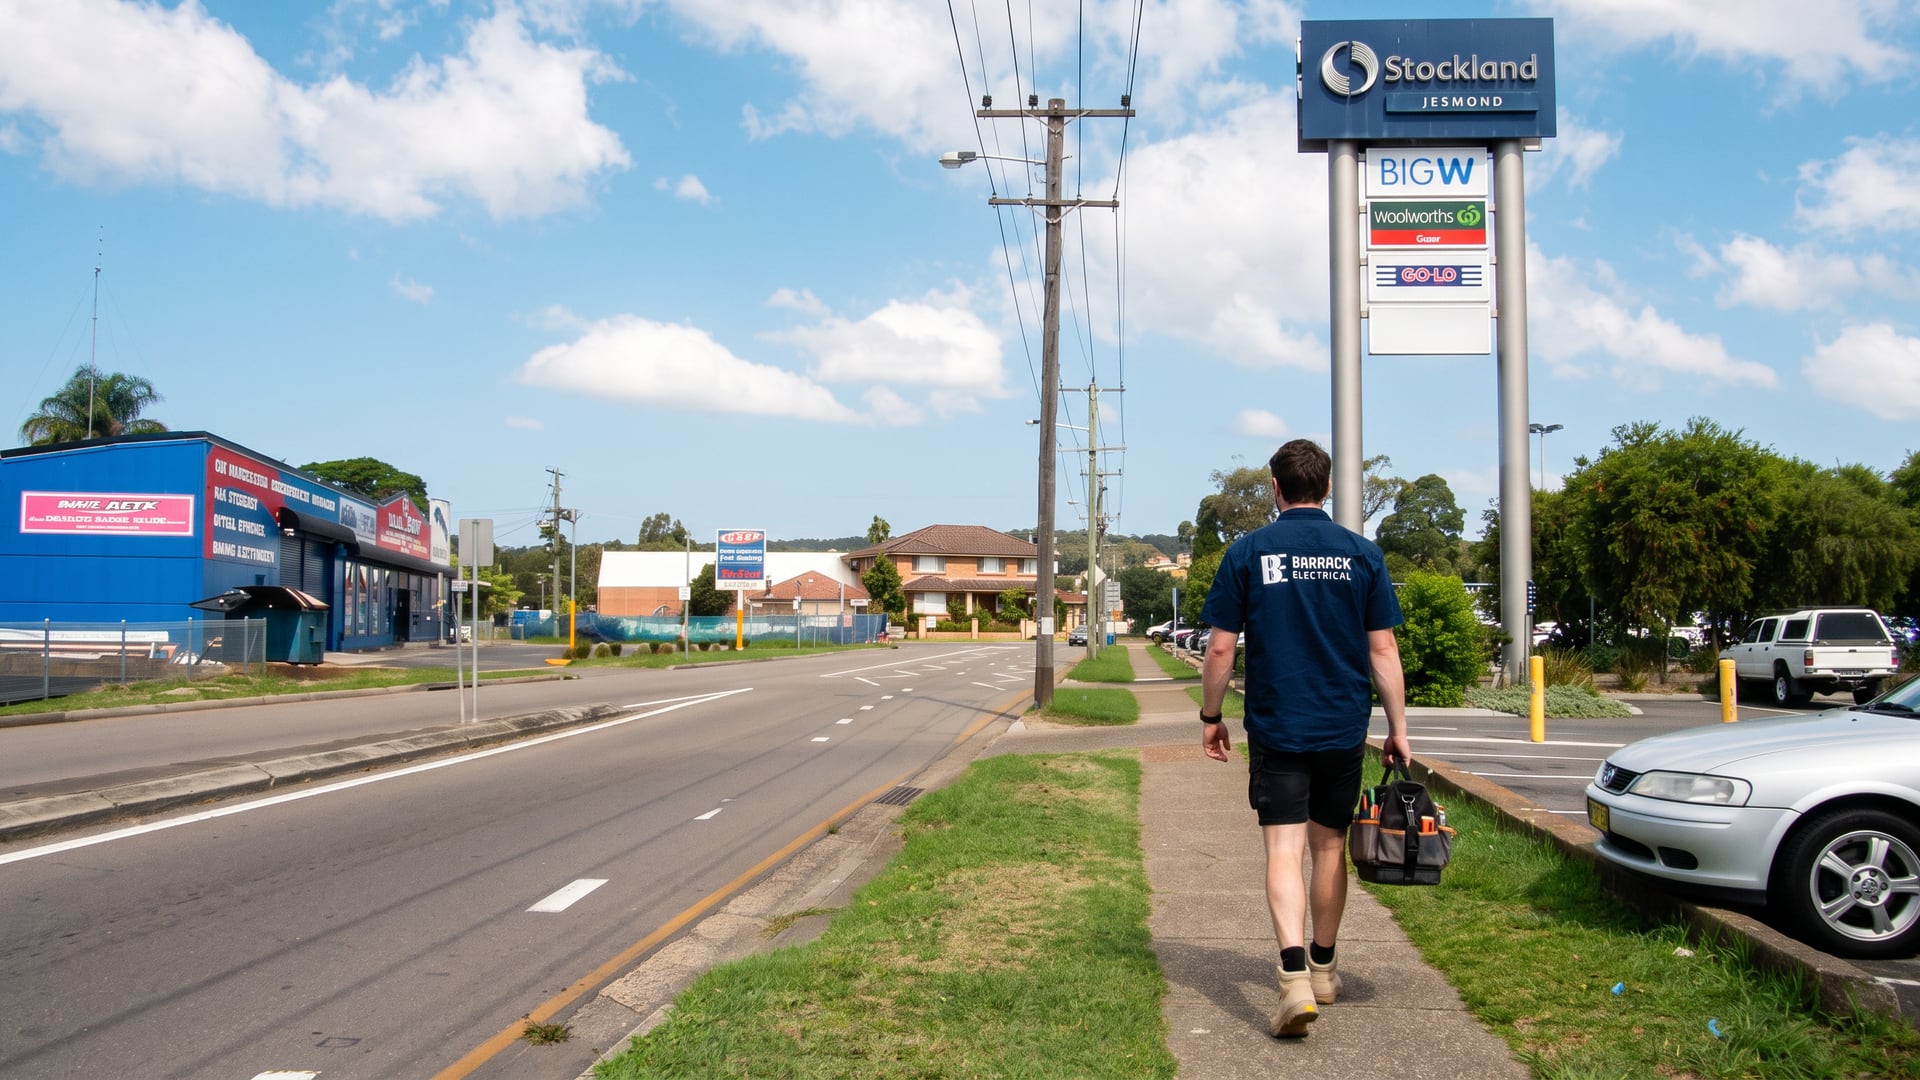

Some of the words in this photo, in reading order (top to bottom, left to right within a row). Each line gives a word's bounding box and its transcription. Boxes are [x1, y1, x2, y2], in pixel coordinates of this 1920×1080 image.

[1385, 53, 1538, 82] Stockland
[1422, 96, 1503, 109] JESMOND
[1401, 267, 1457, 282] GO-LO
[1292, 556, 1351, 570] BARRACK
[1292, 570, 1352, 581] ELECTRICAL
